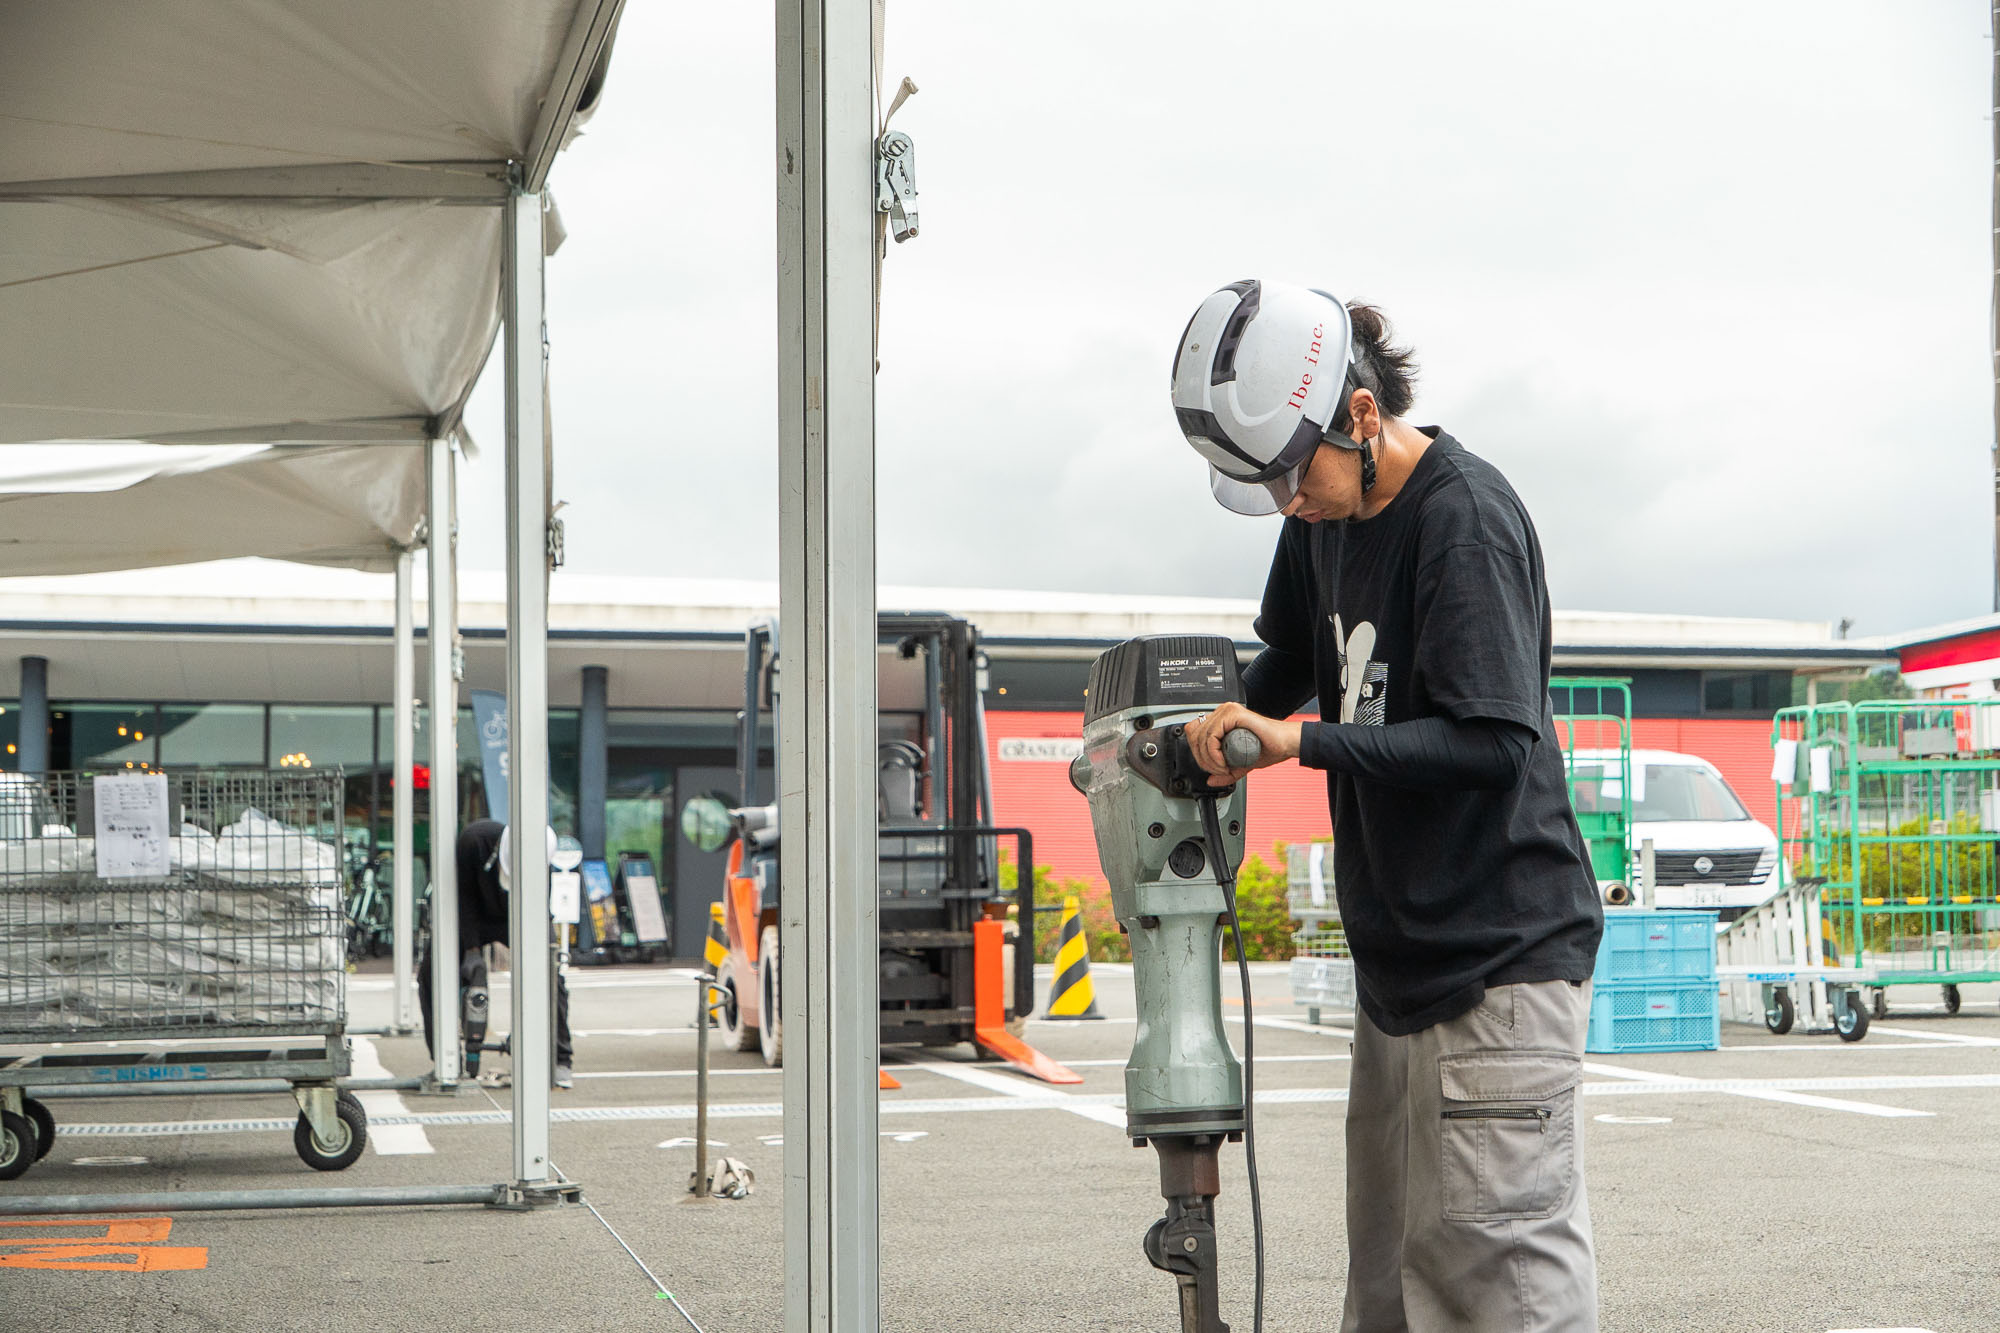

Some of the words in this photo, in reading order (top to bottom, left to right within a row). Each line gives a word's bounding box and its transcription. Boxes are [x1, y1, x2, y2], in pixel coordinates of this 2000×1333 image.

[1287, 373, 1313, 412] Ibe
[1304, 322, 1323, 367] inc.
[116, 1065, 184, 1082] NISHIO
